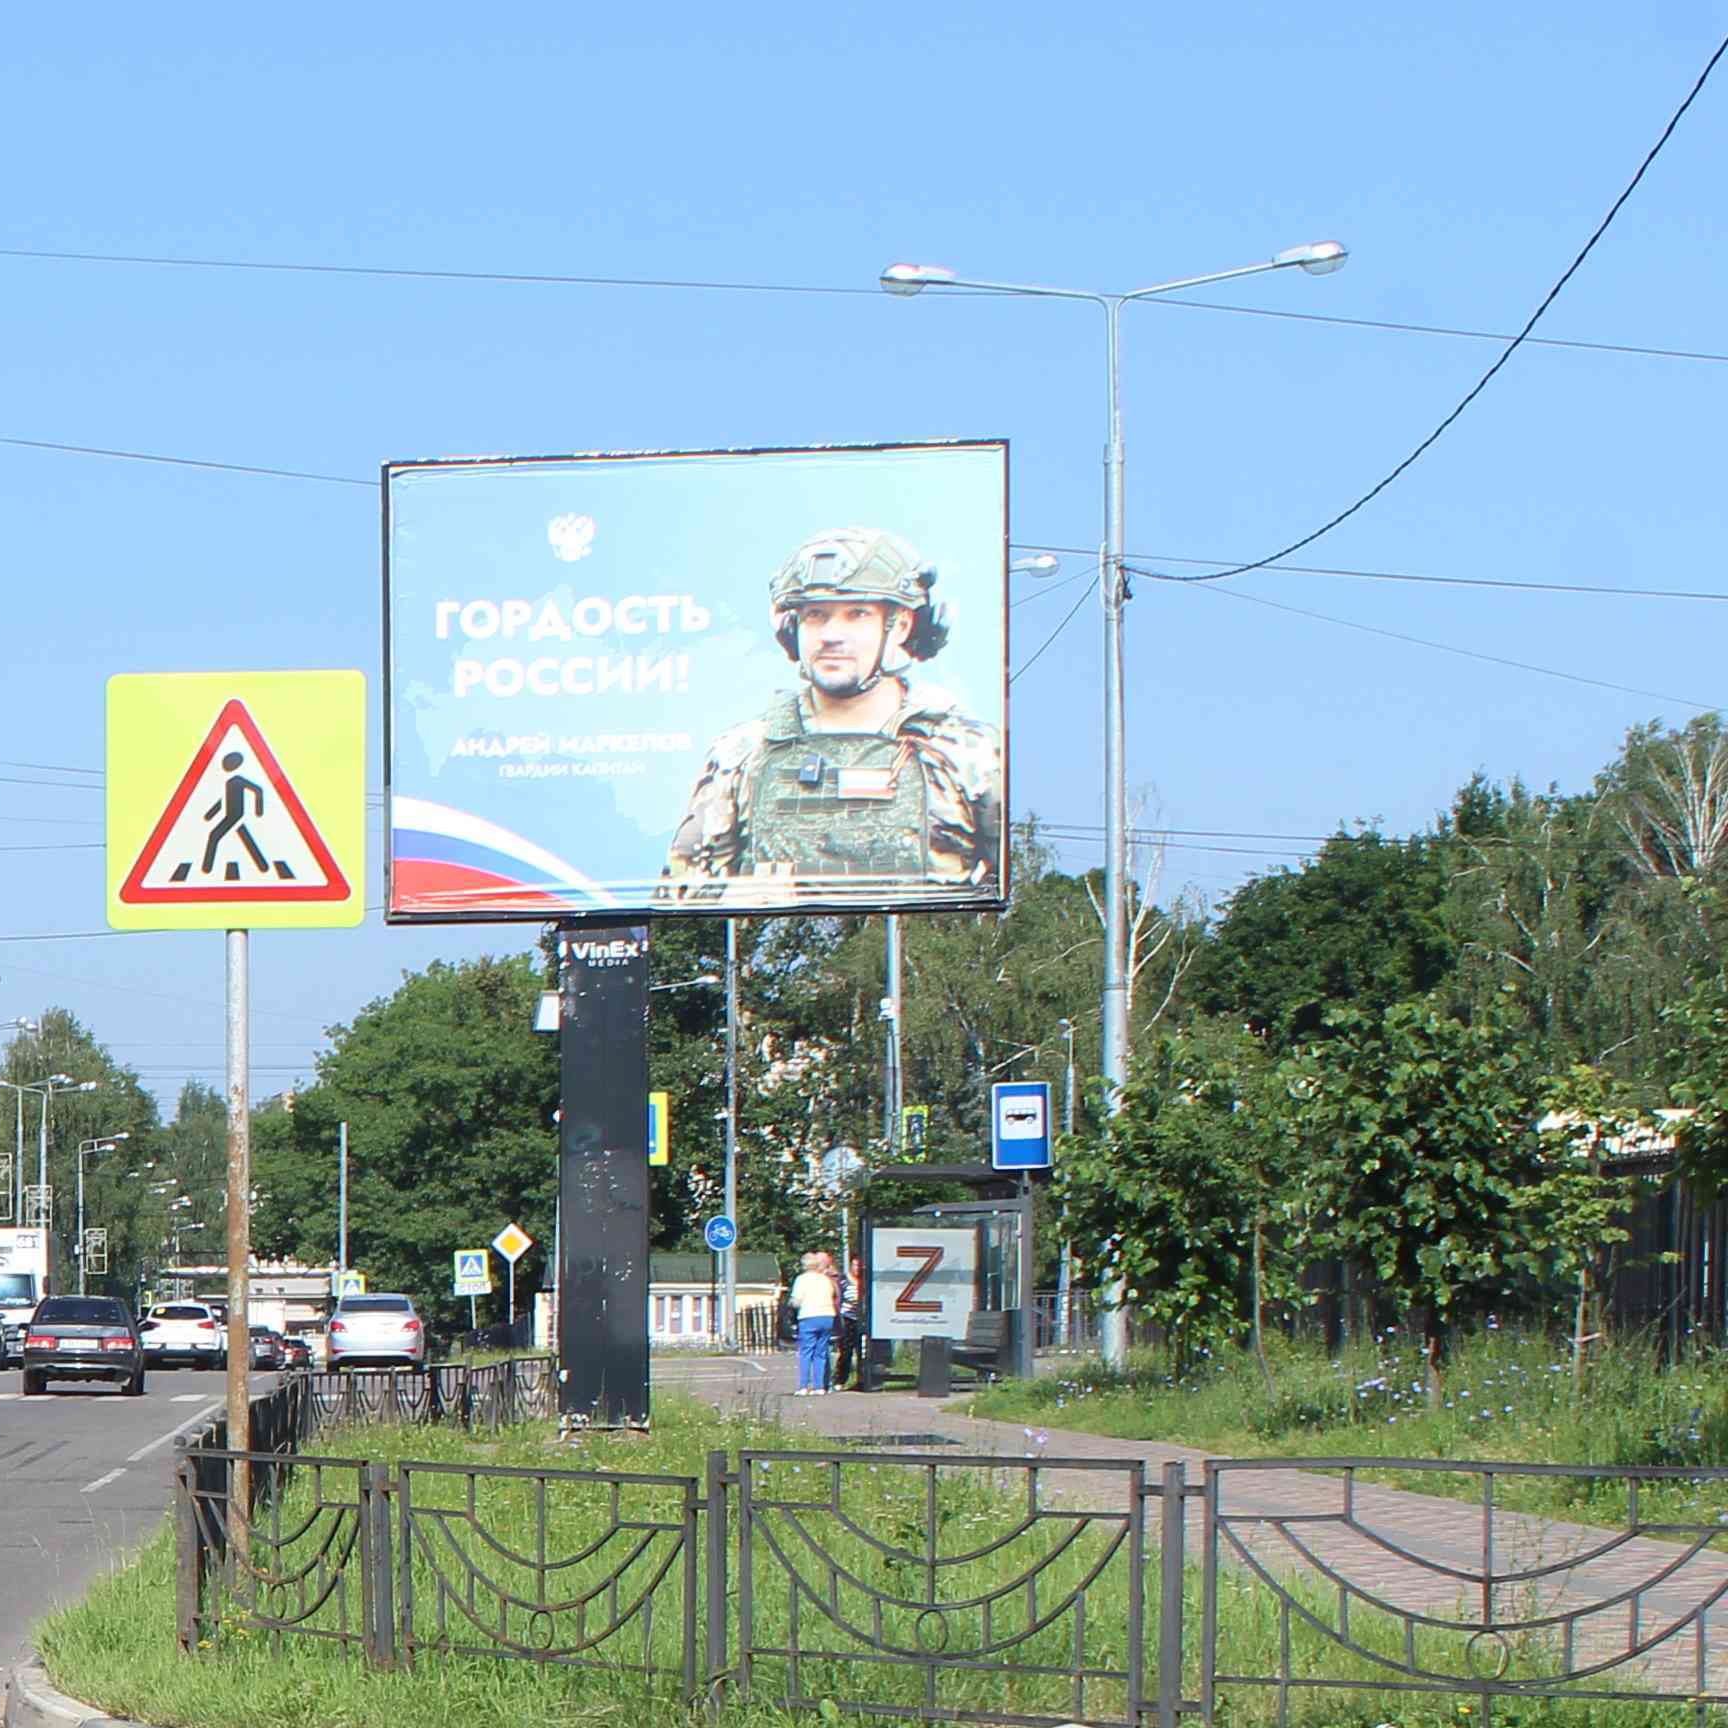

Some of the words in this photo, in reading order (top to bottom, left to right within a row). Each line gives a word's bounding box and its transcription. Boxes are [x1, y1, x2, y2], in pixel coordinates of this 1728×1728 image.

[435, 595, 712, 641] ГОРДОСТЬ
[453, 654, 690, 697] РОССИИ!
[449, 732, 552, 757] АНДРЕЙ
[558, 732, 693, 753] МАРКЕЛОВ
[498, 762, 570, 779] ГВАРДИИ
[571, 760, 645, 777] КАПИТАН
[896, 1246, 944, 1312] Z
